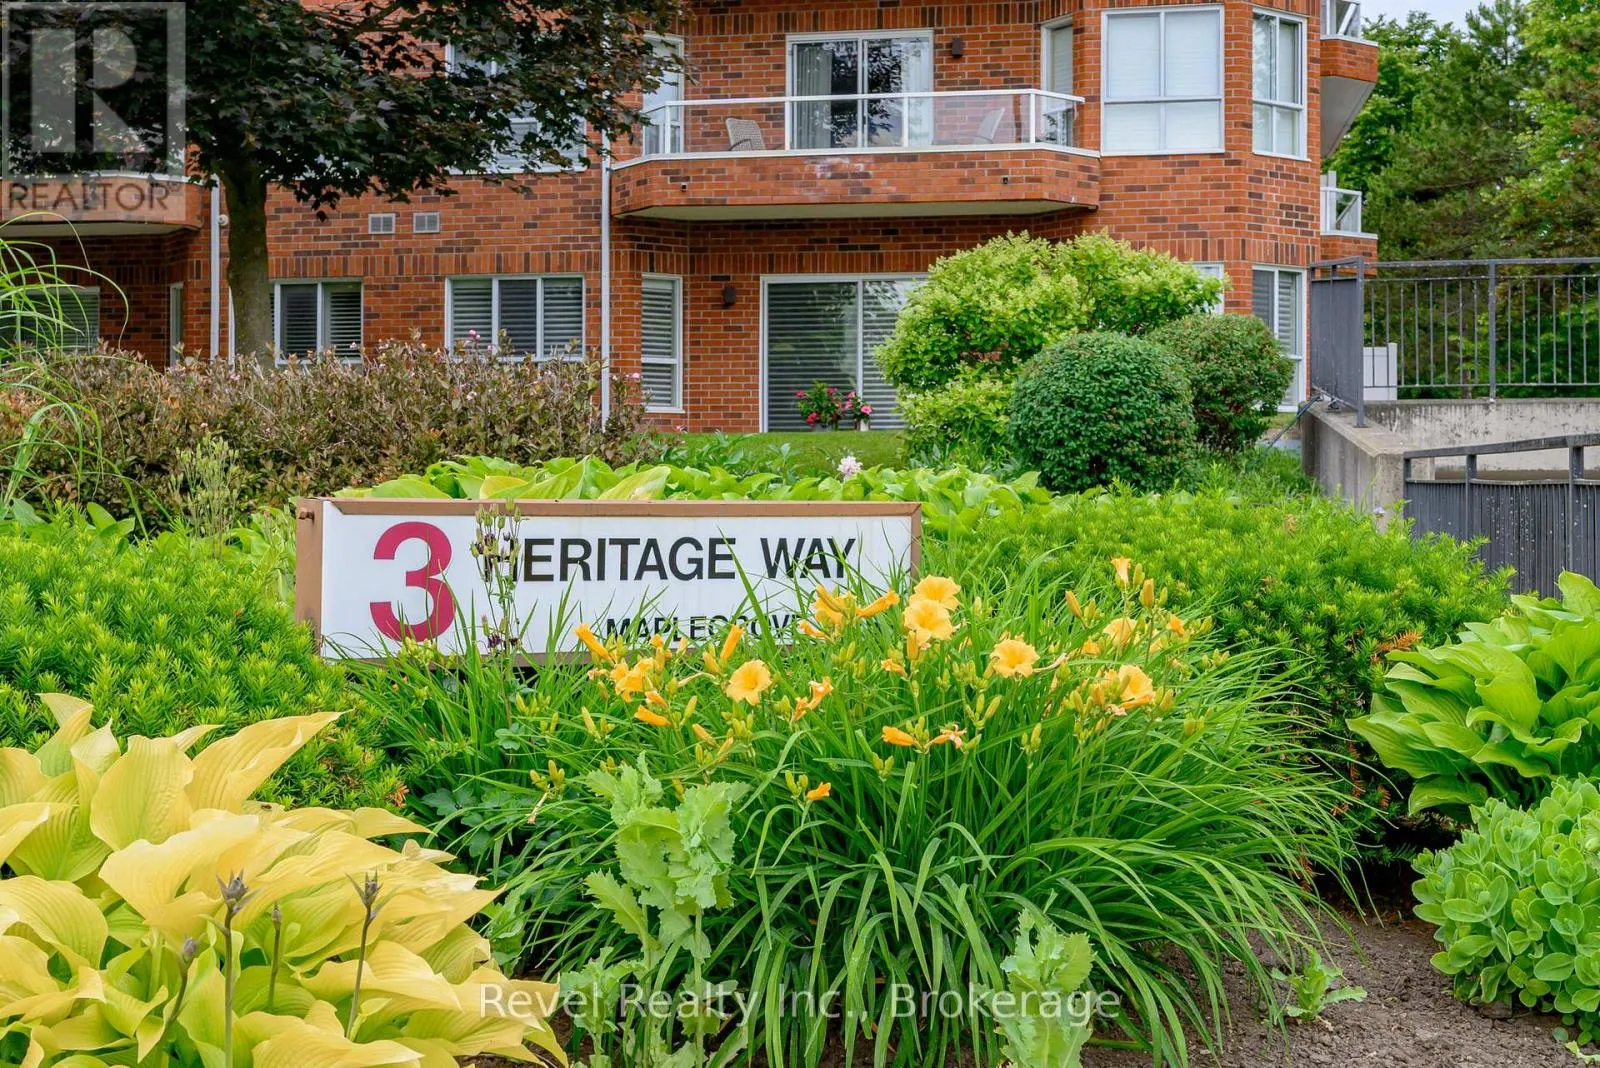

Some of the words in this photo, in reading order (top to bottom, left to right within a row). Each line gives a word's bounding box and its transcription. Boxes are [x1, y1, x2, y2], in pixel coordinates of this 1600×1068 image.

[369, 521, 456, 642] 3
[761, 537, 856, 580] WAY
[606, 615, 803, 642] MAPLEOV
